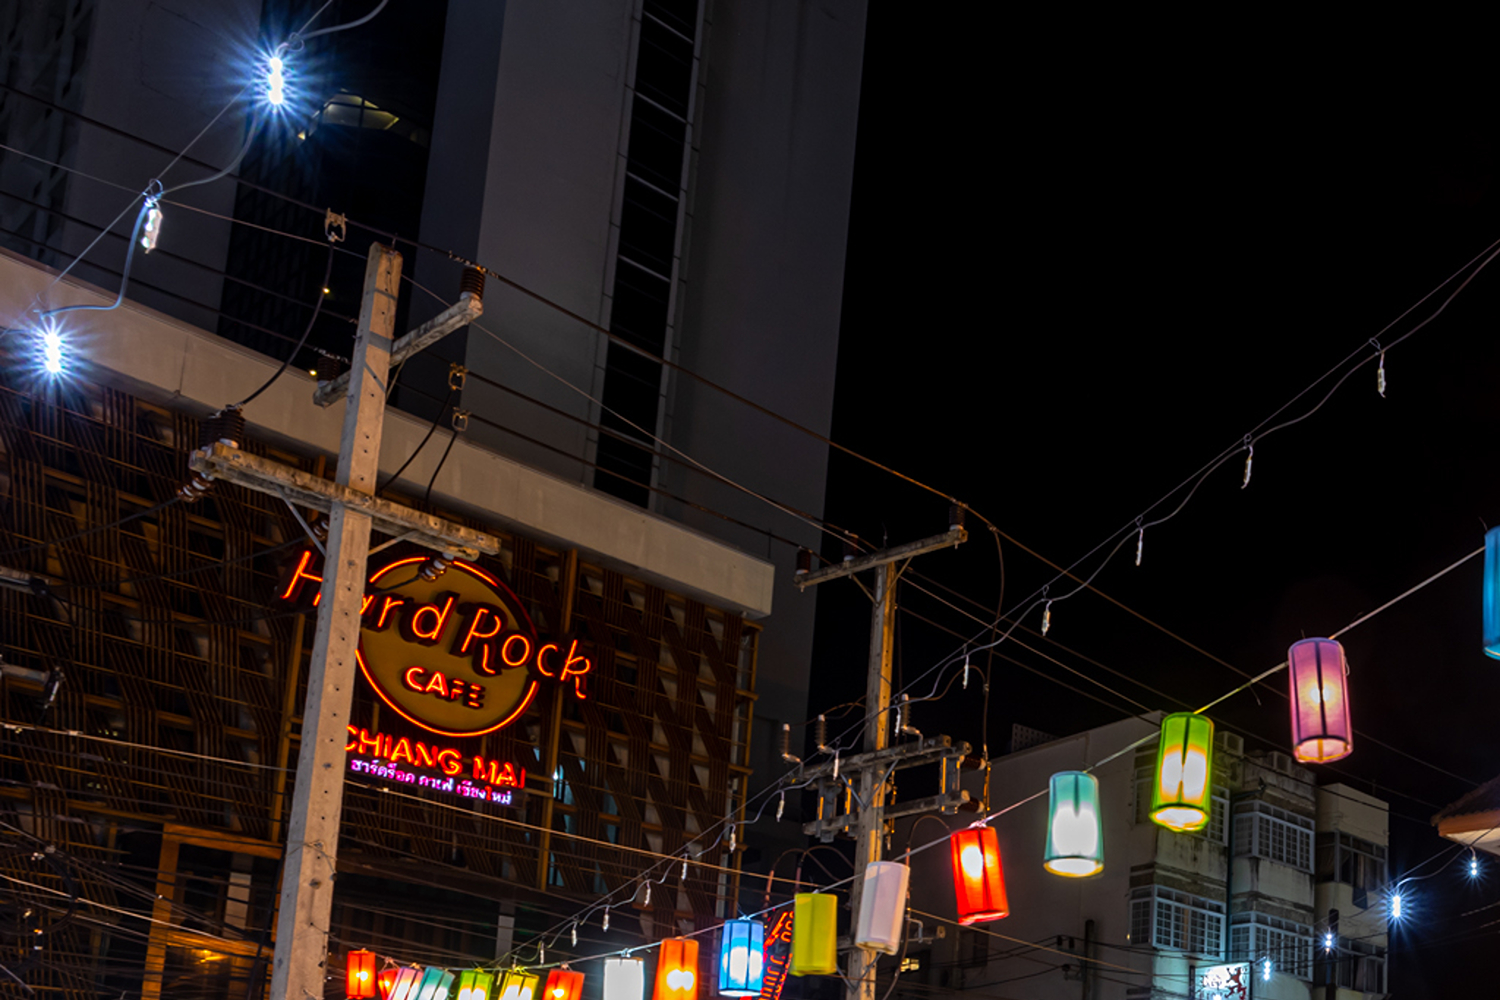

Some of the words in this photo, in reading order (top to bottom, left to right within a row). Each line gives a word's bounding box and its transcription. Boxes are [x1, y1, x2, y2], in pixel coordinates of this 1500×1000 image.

[460, 607, 592, 700] Rock
[343, 724, 462, 776] CHIANG
[471, 756, 527, 790] MAI
